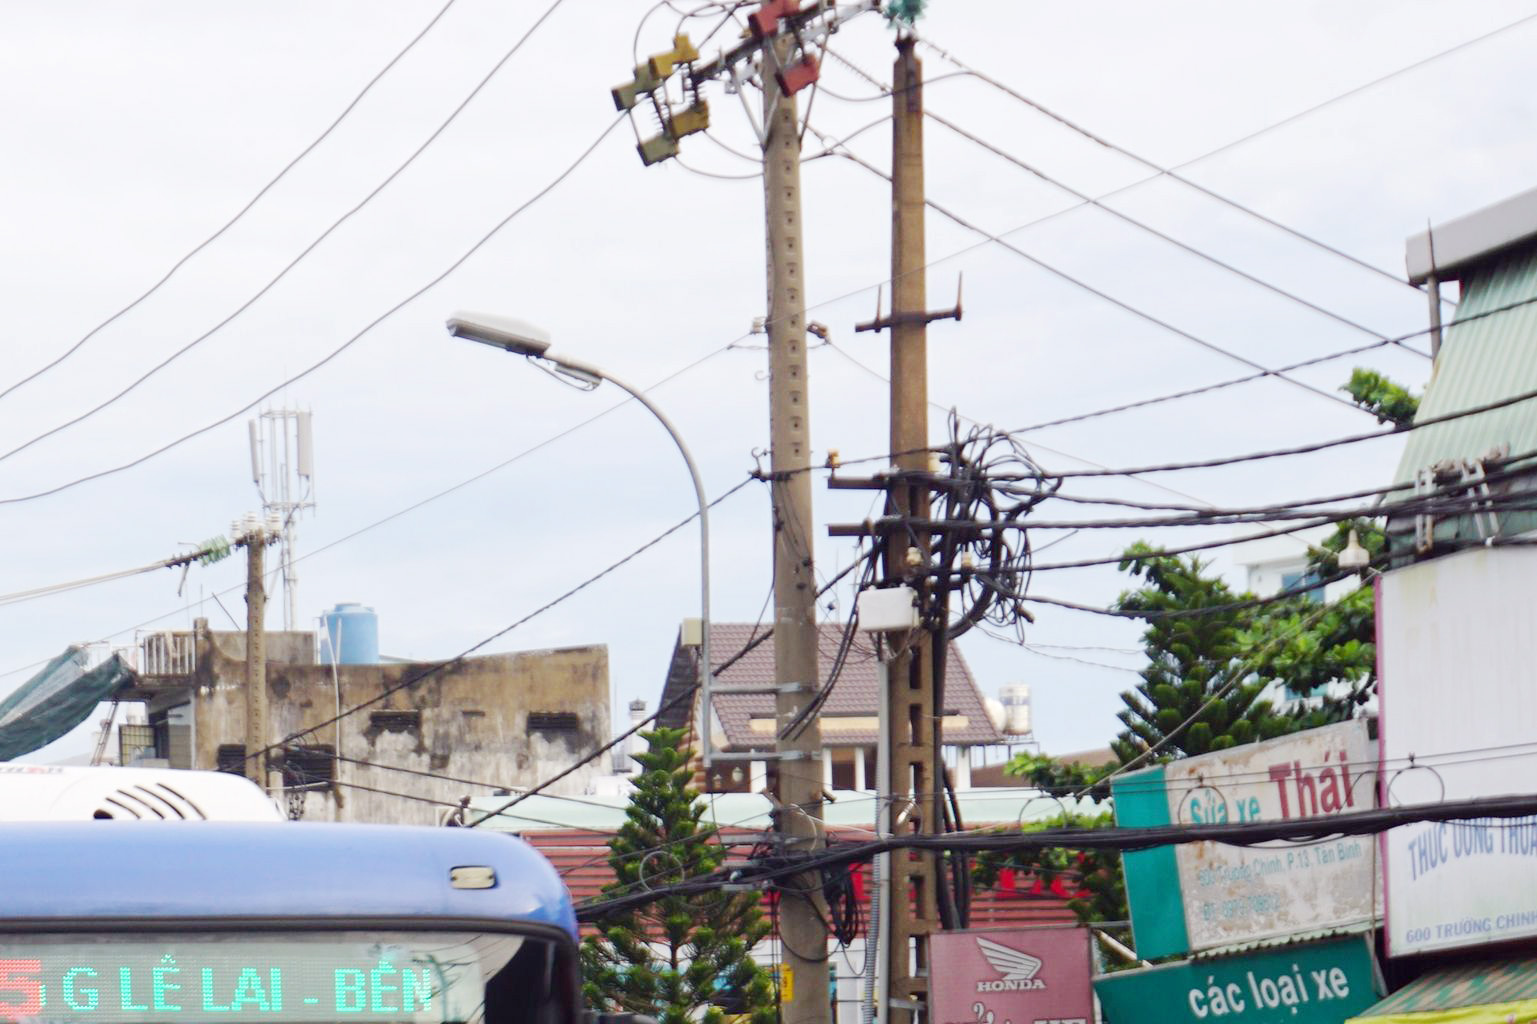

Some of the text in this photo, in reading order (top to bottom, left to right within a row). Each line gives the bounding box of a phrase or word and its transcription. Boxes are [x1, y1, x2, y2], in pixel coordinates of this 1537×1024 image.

[1268, 751, 1354, 822] Thái
[1236, 796, 1262, 824] xe
[1406, 927, 1431, 944] 600
[120, 954, 183, 1012] LÊ
[201, 966, 283, 1012] LAI
[976, 979, 1046, 992] HONDA
[1188, 963, 1350, 1019] các loại xe
